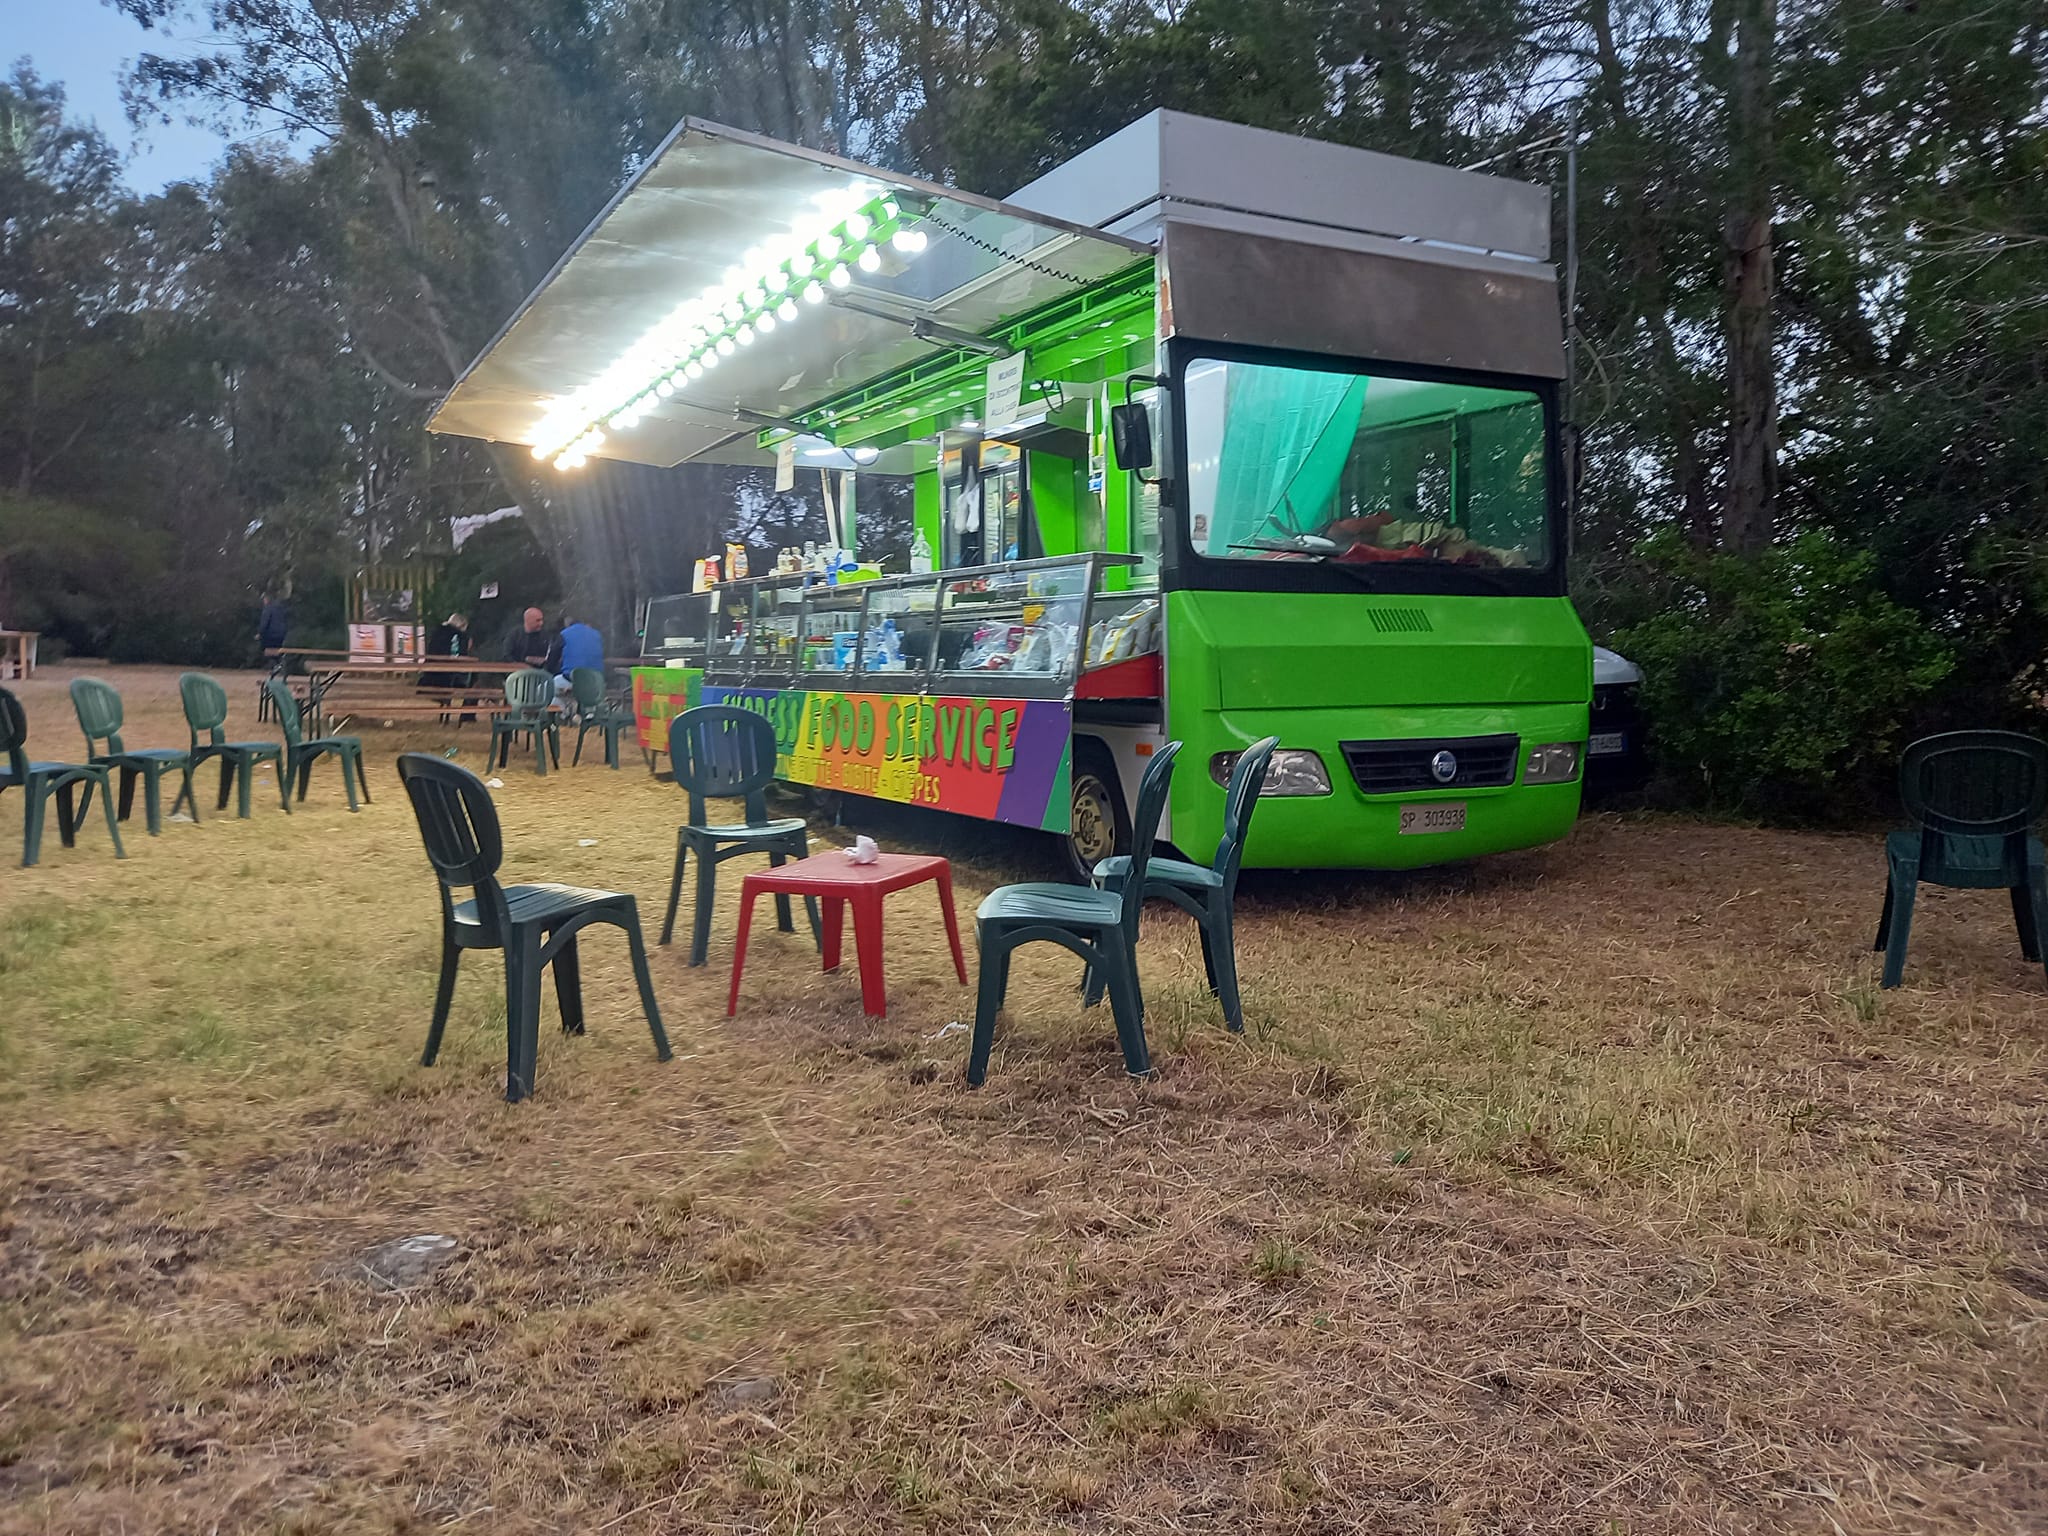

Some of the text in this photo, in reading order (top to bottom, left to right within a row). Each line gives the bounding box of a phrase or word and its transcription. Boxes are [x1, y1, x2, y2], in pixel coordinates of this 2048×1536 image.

[807, 698, 876, 755] FOOD
[884, 702, 1018, 771] SERVICE
[1402, 811, 1416, 829] SP
